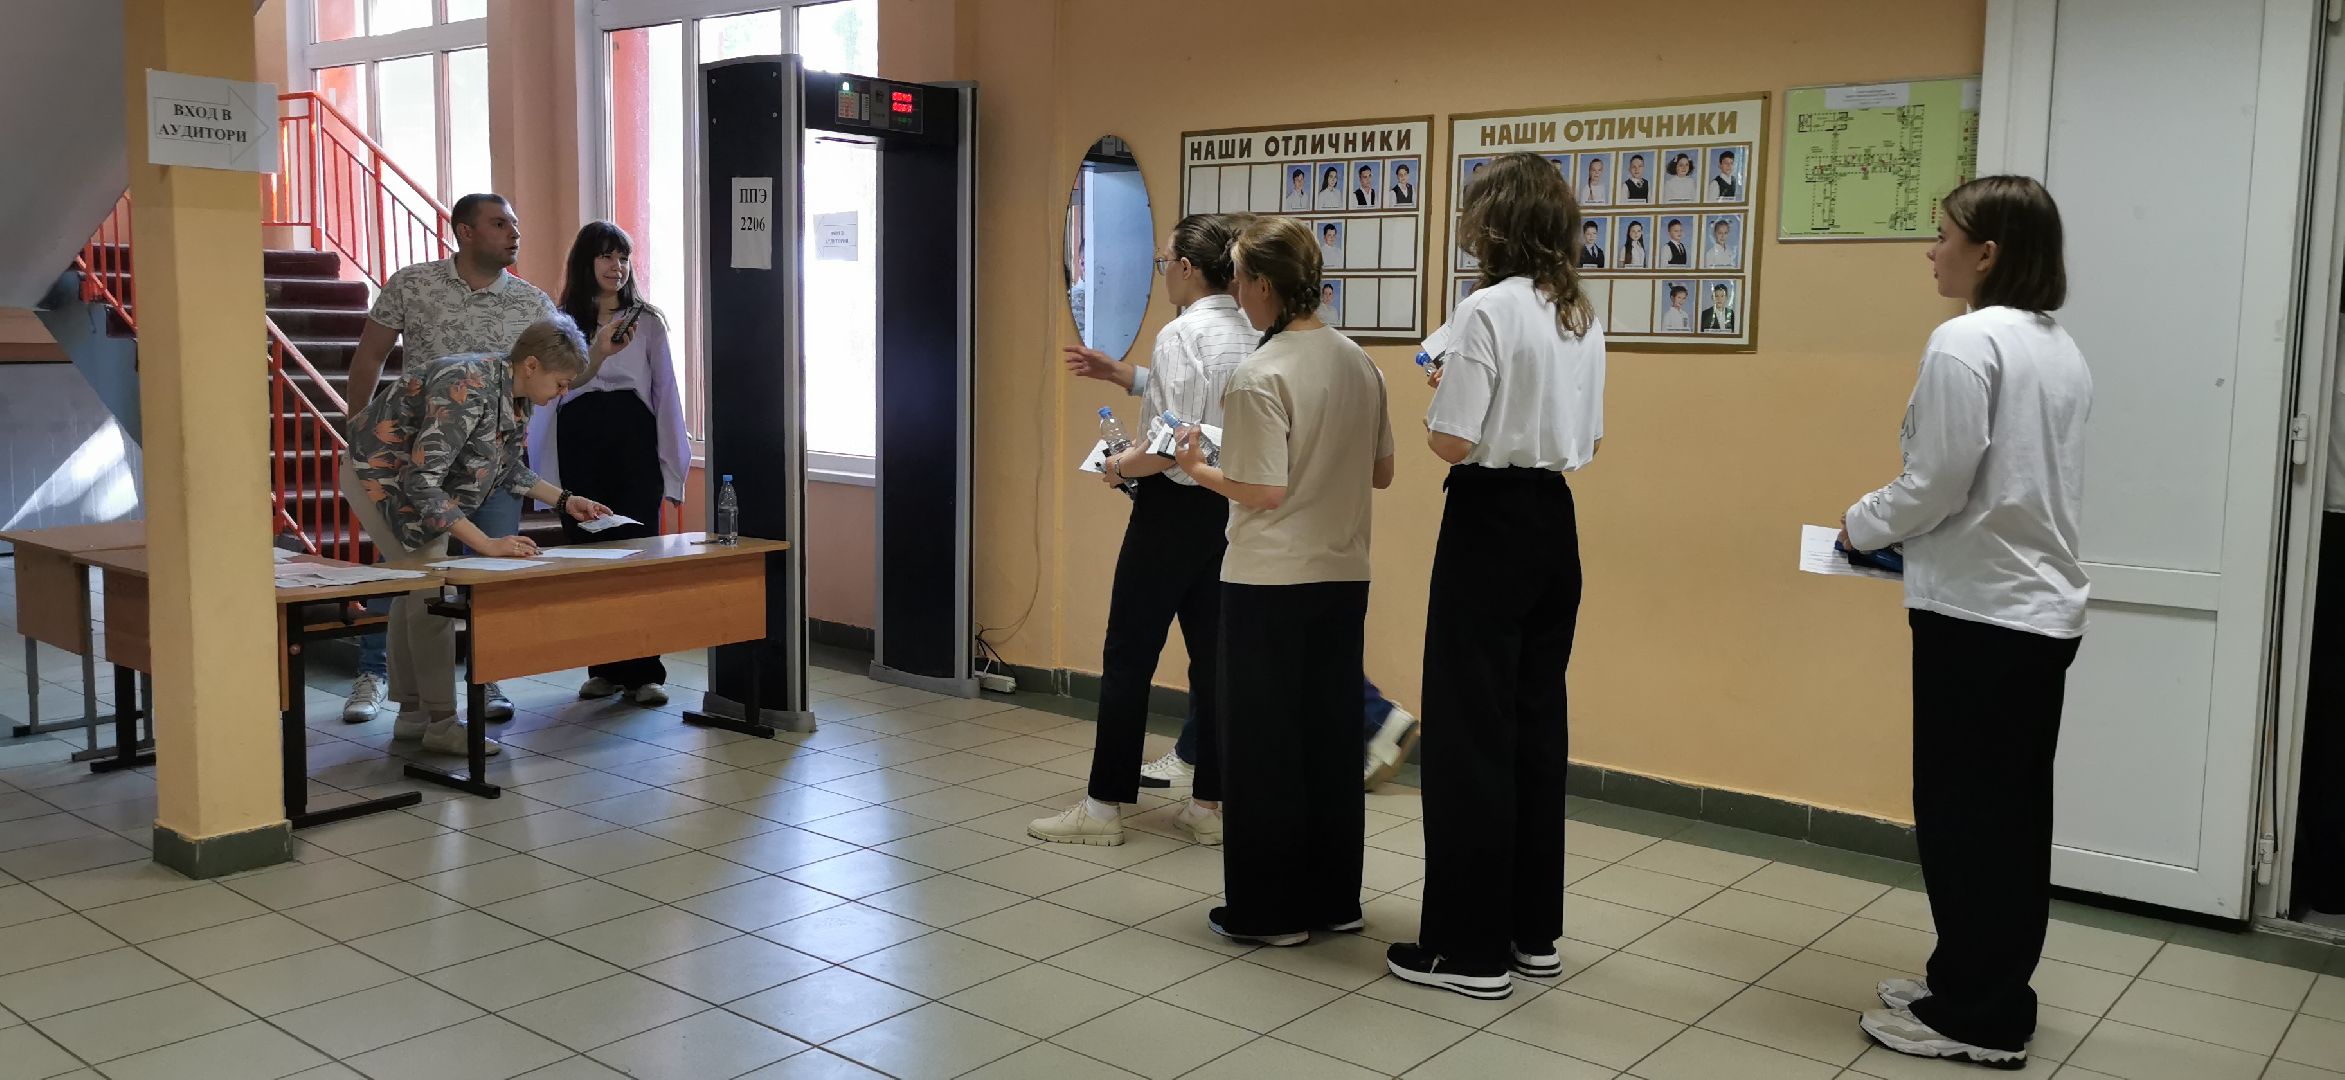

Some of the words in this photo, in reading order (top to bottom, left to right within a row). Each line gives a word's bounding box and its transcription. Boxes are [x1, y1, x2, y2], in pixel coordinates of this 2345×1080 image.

[173, 104, 219, 121] ВХОД
[222, 108, 233, 121] В
[159, 123, 248, 143] АУДИТОРИ
[1480, 121, 1556, 147] НАШИ
[1563, 110, 1738, 143] ОТЛИЧНИКИ
[1190, 137, 1252, 161] НАШИ
[1264, 128, 1412, 157] ОТЛИЧНИКИ
[739, 188, 767, 204] ППЭ
[740, 216, 766, 232] 2206
